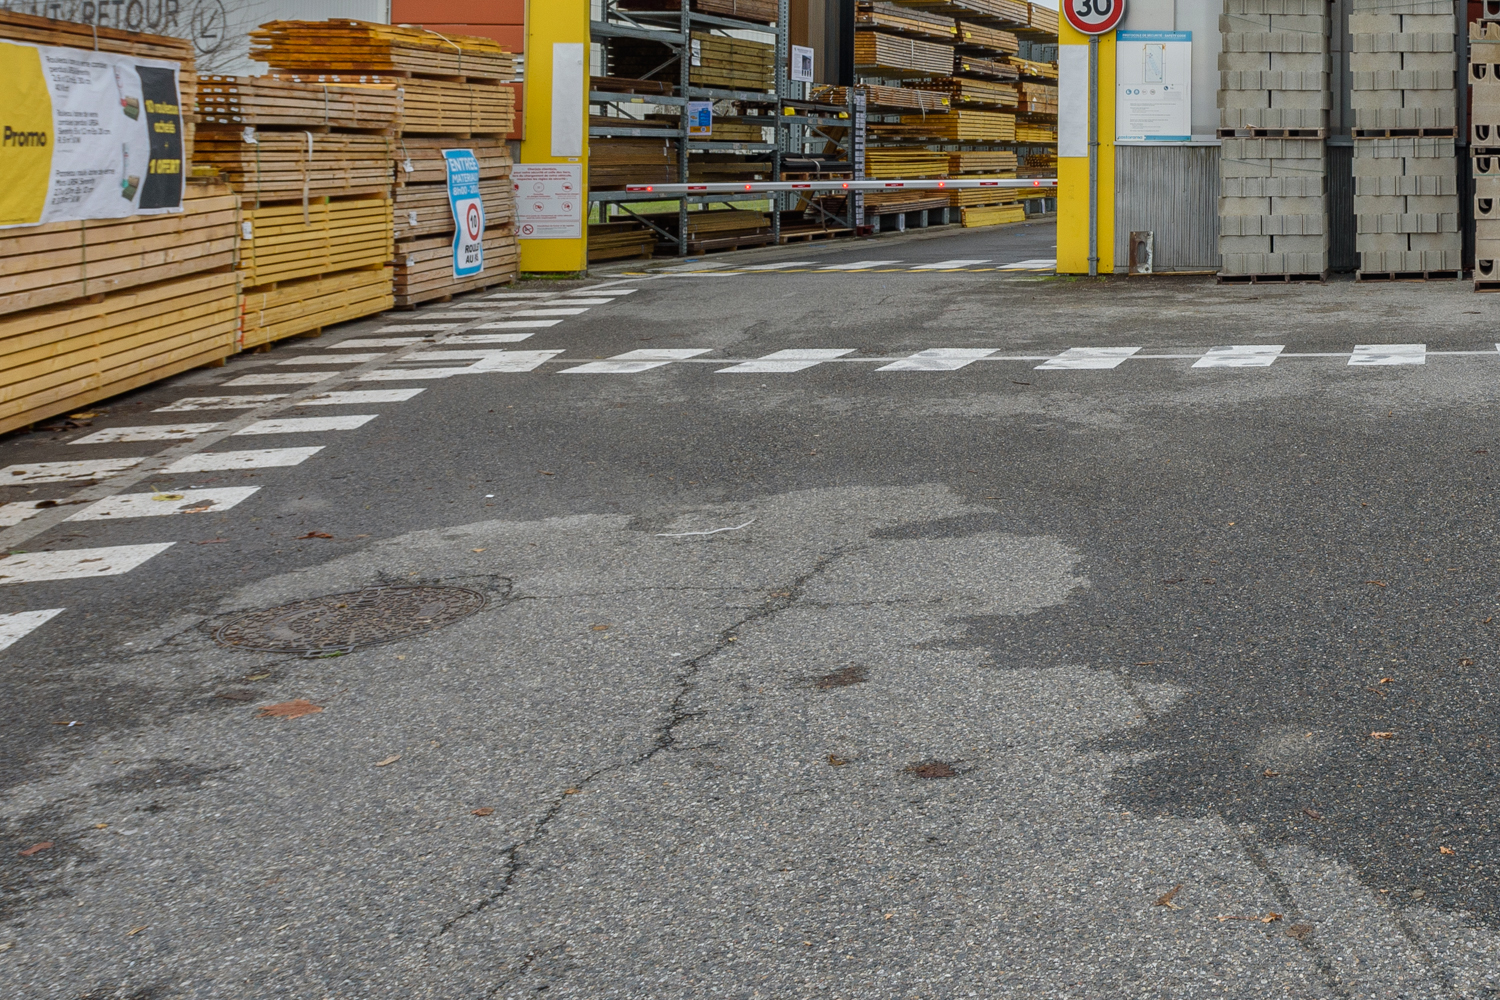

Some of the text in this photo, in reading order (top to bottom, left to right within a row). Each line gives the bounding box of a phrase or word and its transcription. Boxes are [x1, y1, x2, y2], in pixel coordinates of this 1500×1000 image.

[3, 125, 47, 147] Promo
[453, 186, 468, 196] 8h00
[470, 215, 477, 228] 10
[466, 255, 474, 264] AU
